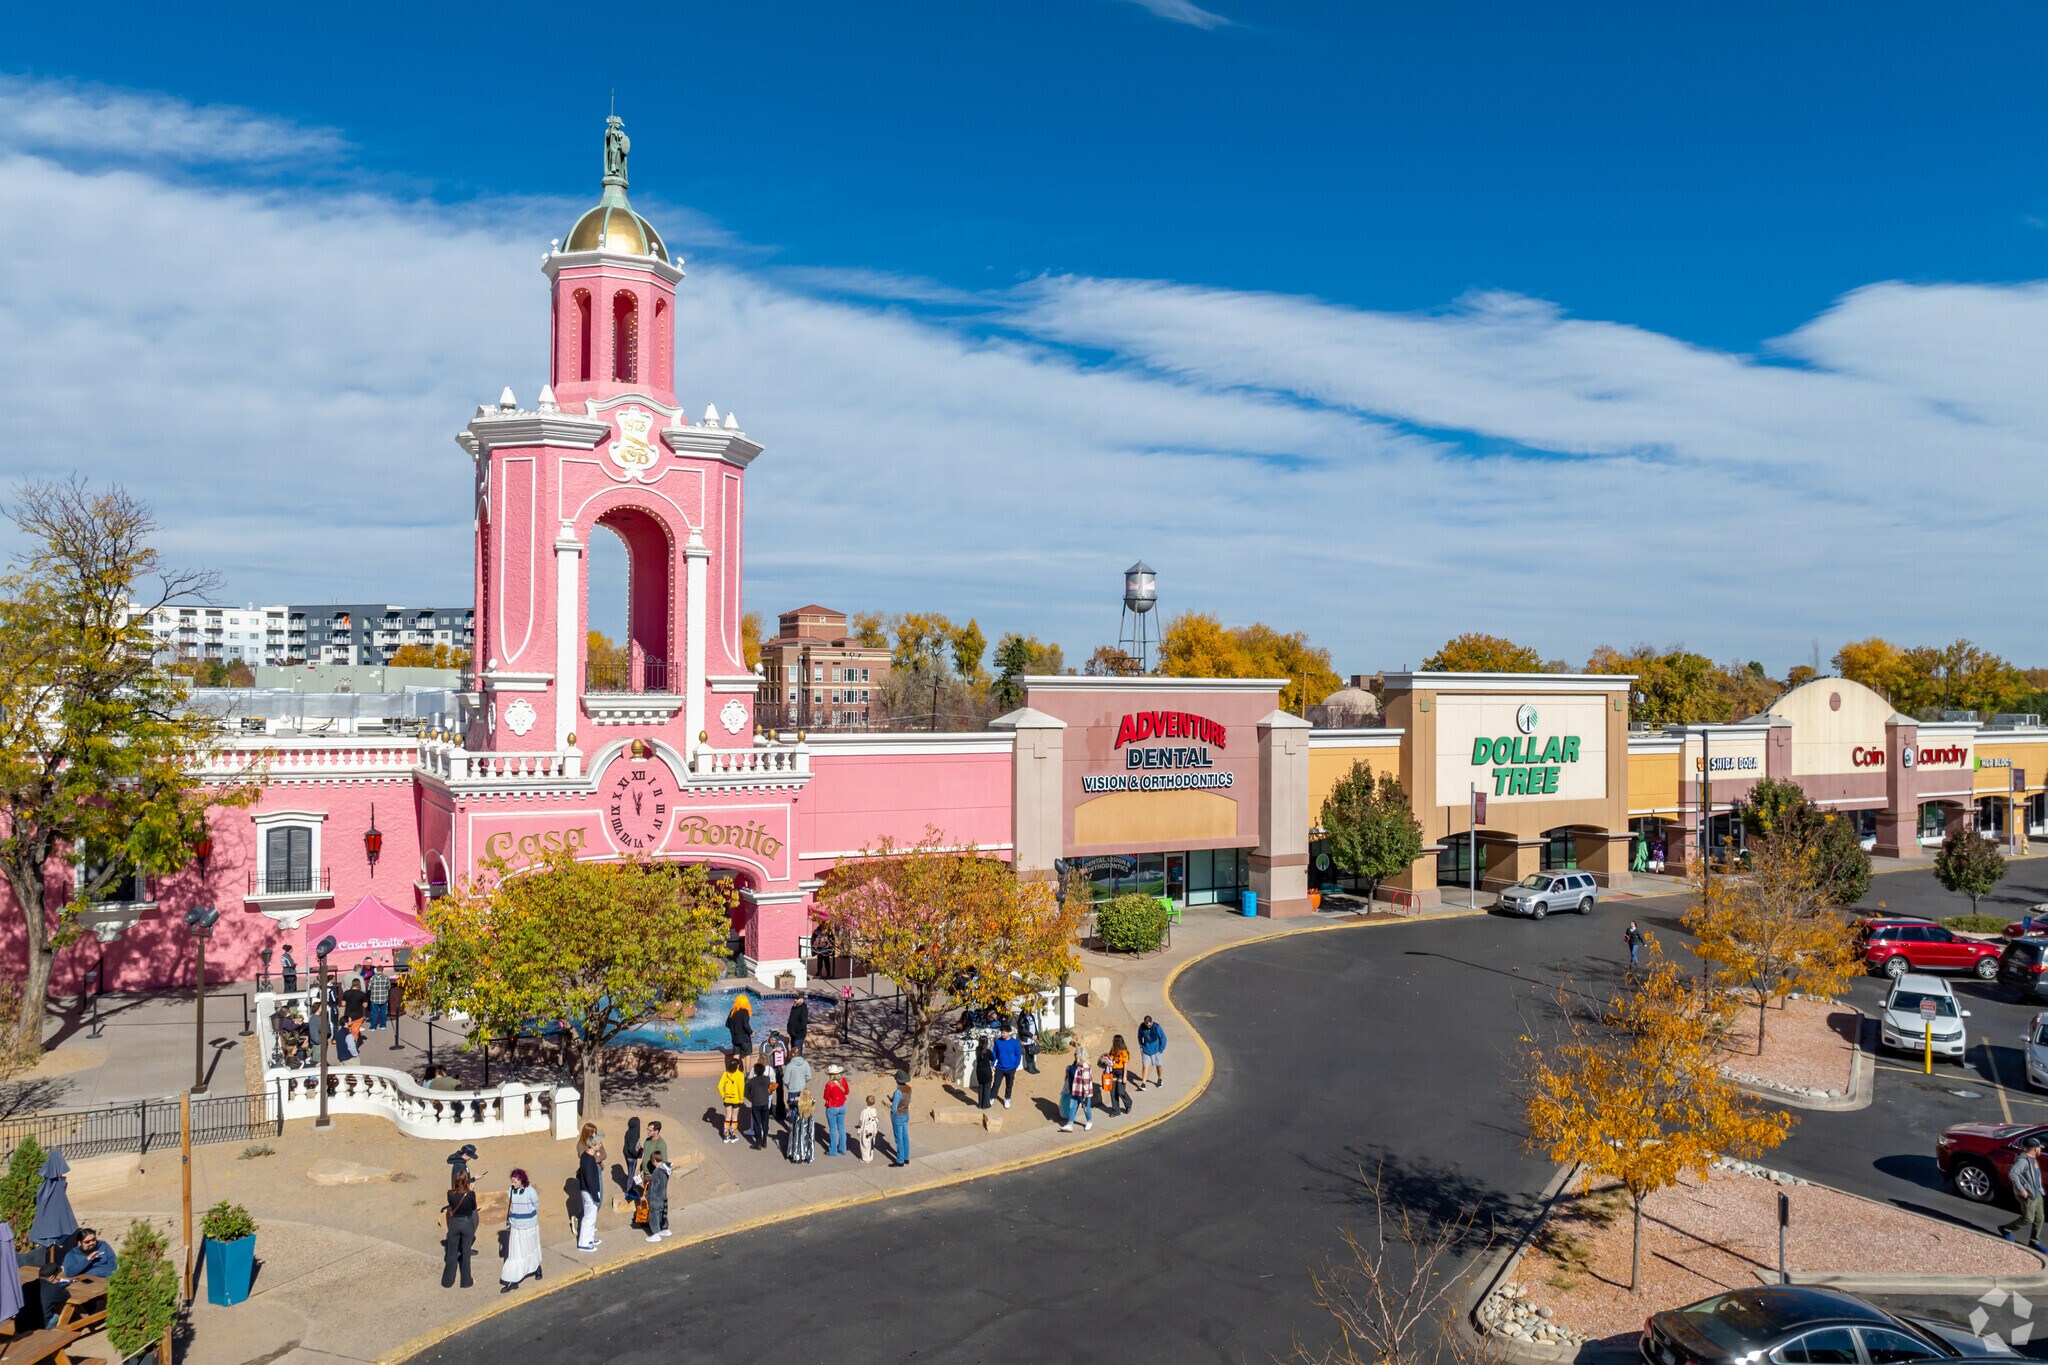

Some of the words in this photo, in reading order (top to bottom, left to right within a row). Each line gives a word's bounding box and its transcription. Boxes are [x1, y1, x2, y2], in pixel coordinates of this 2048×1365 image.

[1115, 710, 1227, 749] ADVENTURE
[1471, 735, 1581, 765] DOLLAR
[1852, 746, 1885, 767] Coin
[1126, 746, 1214, 769] DENTAL
[1710, 757, 1735, 771] SHIBA
[1738, 756, 1758, 770] BOBA
[631, 771, 646, 781] XII
[647, 777, 656, 786] I
[1082, 775, 1127, 793] VISION
[1128, 775, 1140, 791] &
[1141, 772, 1233, 792] ORTHODONTICS
[1492, 766, 1561, 795] TREE
[617, 777, 630, 790] XI
[612, 791, 622, 800] X
[653, 788, 663, 797] II
[611, 804, 620, 816] IX
[656, 803, 665, 814] III
[611, 817, 624, 836] VIII
[652, 818, 663, 831] IV
[485, 826, 587, 863] Casa
[678, 815, 784, 861] Bonita
[619, 832, 632, 847] VII
[634, 838, 644, 848] VI
[646, 833, 656, 842] V
[338, 941, 368, 951] Casa
